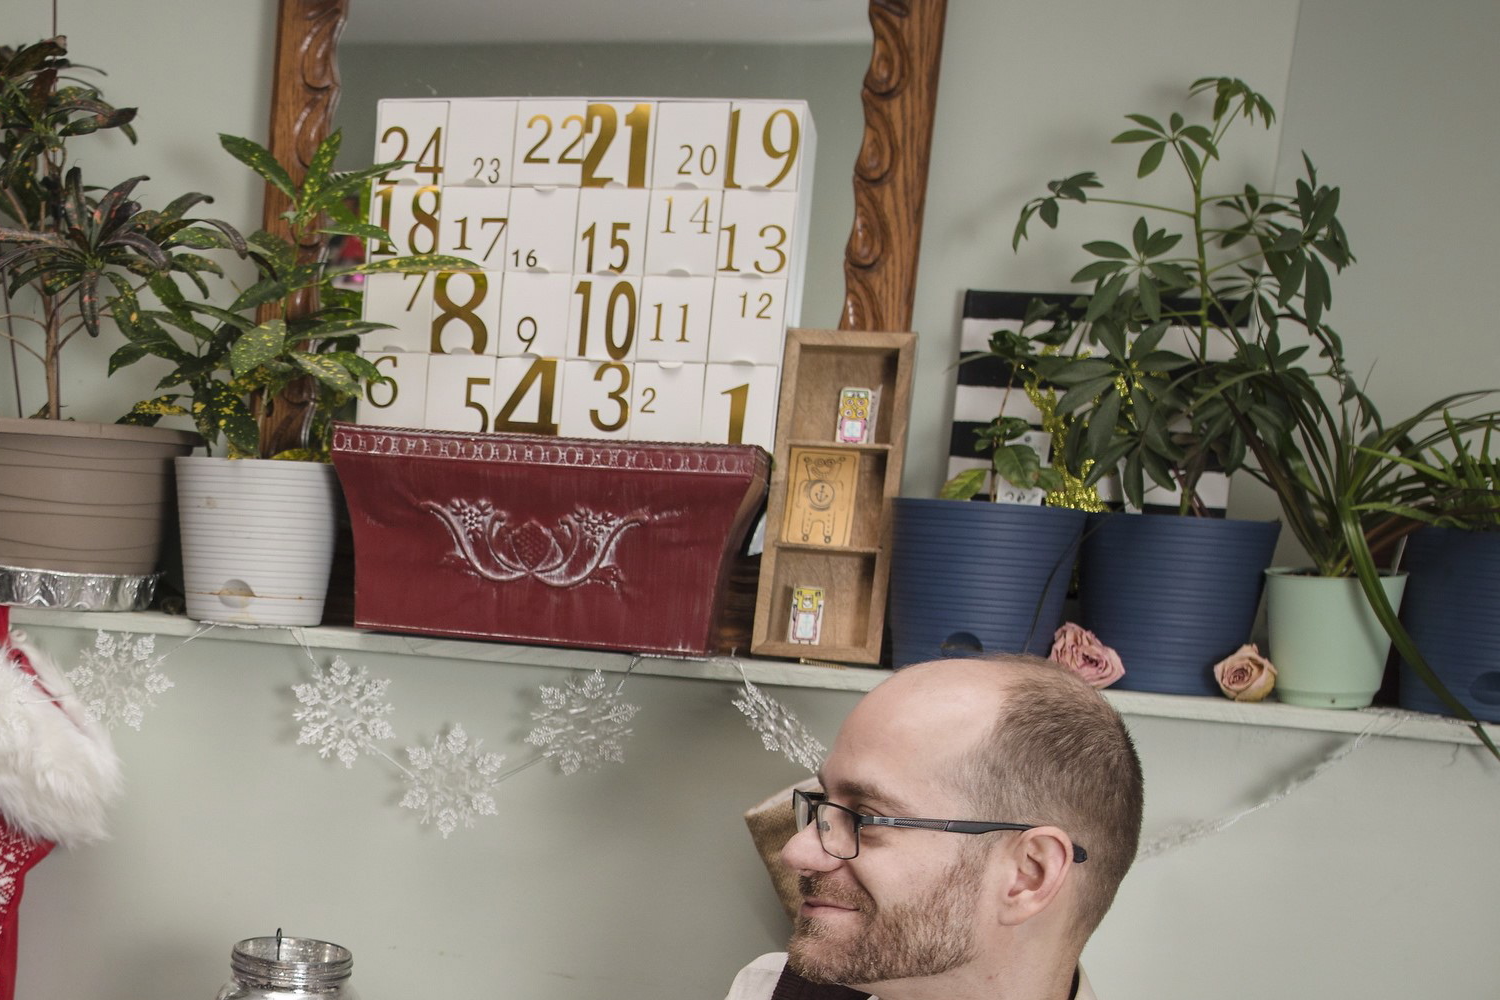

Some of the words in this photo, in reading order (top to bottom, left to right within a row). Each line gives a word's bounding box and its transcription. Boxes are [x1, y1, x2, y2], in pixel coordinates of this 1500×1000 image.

[379, 126, 444, 186] 24
[523, 114, 585, 165] 22
[581, 103, 652, 189] 21
[677, 144, 718, 176] 20
[724, 108, 800, 189] 19
[472, 157, 501, 184] 23
[371, 185, 442, 256] 18
[452, 217, 509, 263] 17
[660, 195, 714, 235] 14
[512, 249, 538, 268] 16
[581, 222, 632, 275] 15
[718, 223, 788, 274] 13
[403, 271, 429, 312] 7
[430, 269, 489, 355] 8
[739, 291, 773, 320] 12
[517, 316, 538, 353] 9
[574, 280, 637, 361] 10
[649, 302, 690, 343] 11
[366, 355, 399, 409] 6
[465, 377, 491, 433] 5
[494, 357, 559, 437] 4
[589, 361, 631, 433] 3
[640, 387, 657, 414] 2
[720, 383, 750, 446] 1
